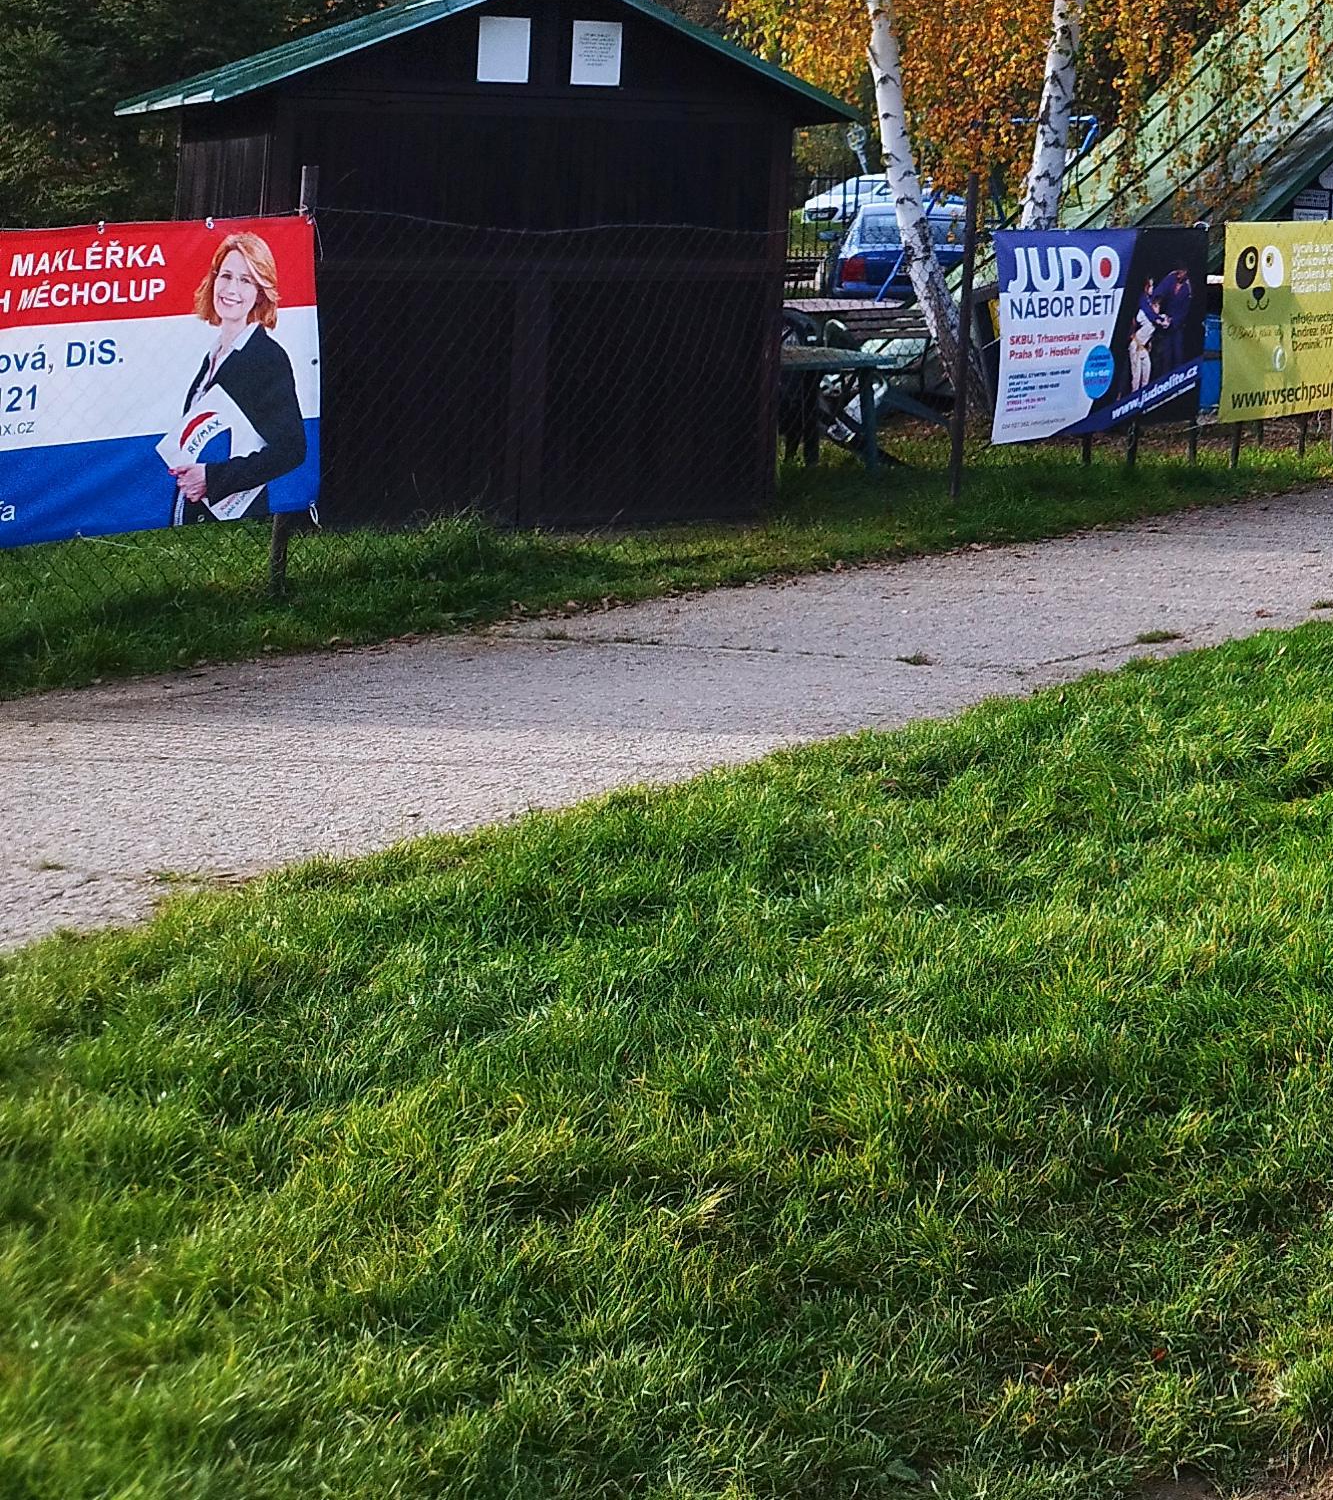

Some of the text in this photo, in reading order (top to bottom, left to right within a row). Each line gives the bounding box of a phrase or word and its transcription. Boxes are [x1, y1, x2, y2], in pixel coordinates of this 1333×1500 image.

[9, 240, 166, 277] MAKLÉŘKA
[1008, 245, 1120, 292] JUDO
[1010, 289, 1116, 319] NÁBOR DĚTÍ
[66, 339, 124, 368] DiS.
[1009, 349, 1032, 360] Praha
[1112, 365, 1198, 420] www.judoelite.cz
[187, 419, 222, 455] RE/MAX
